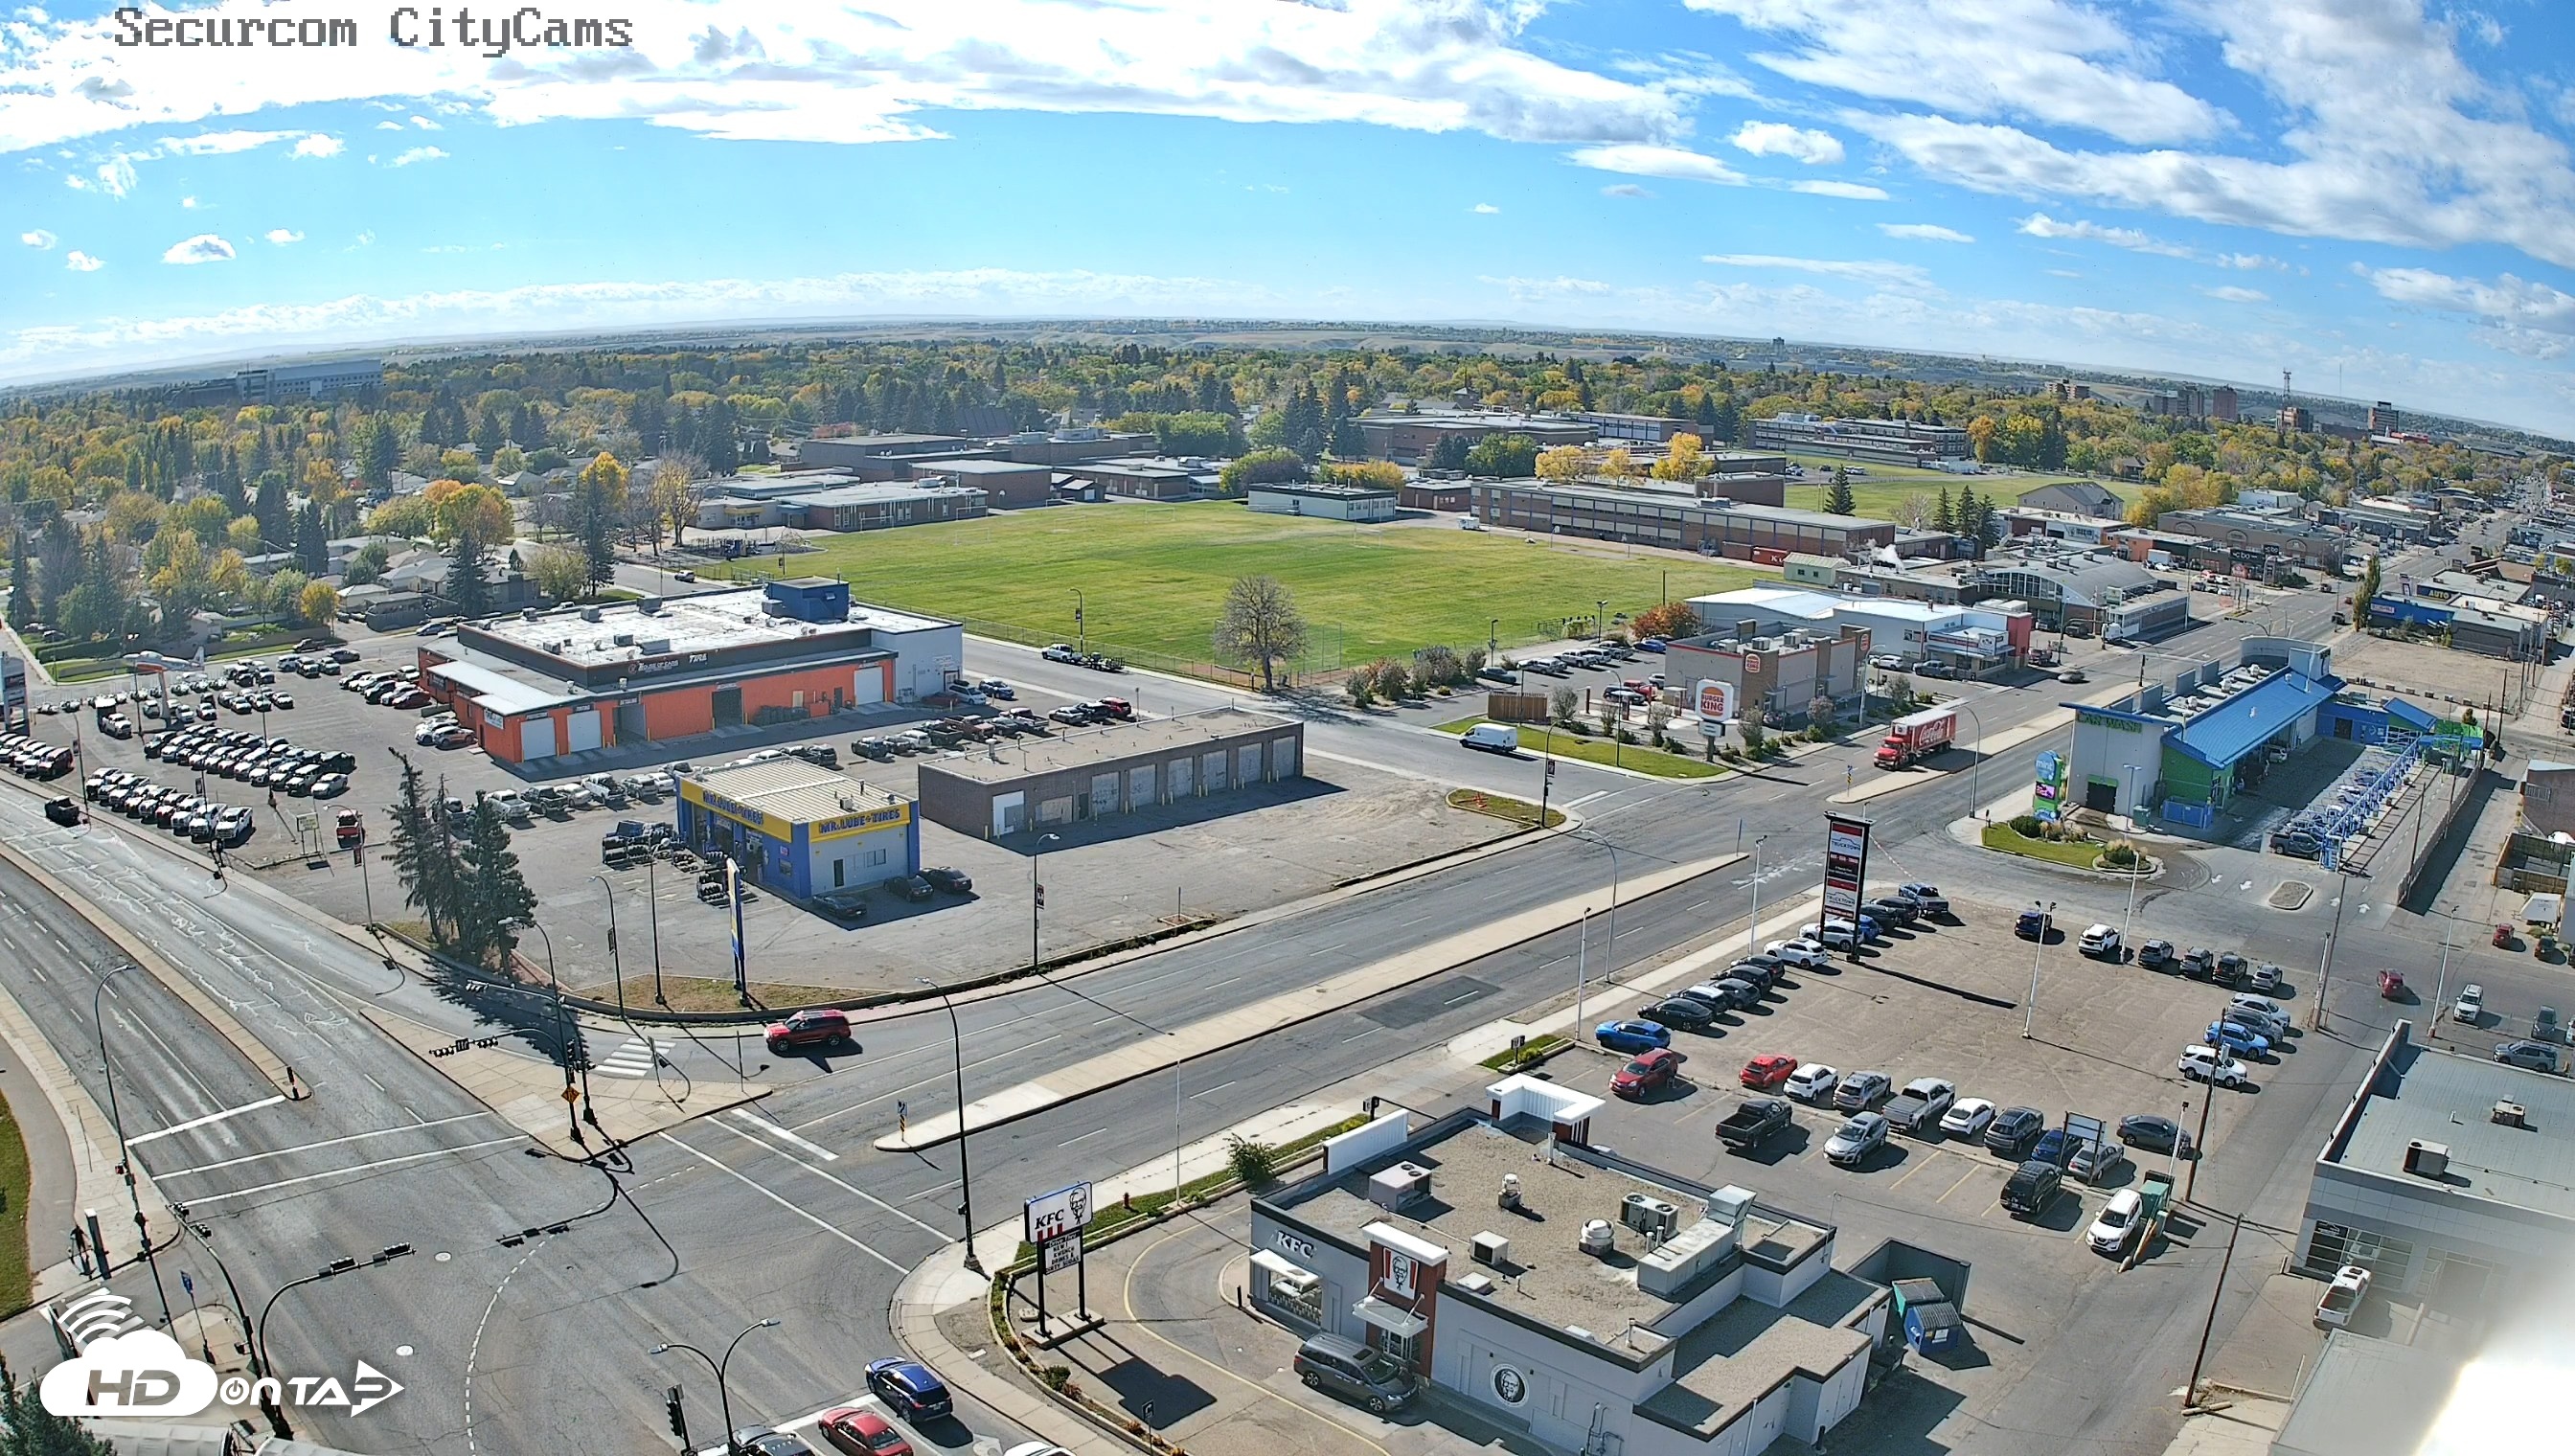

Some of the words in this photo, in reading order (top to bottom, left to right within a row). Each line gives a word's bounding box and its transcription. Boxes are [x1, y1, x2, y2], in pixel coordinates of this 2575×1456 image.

[2428, 590, 2450, 600] AUTO
[1701, 694, 1724, 704] BURGER
[1700, 700, 1724, 712] KING
[2076, 711, 2103, 726] CAR
[2106, 717, 2143, 734] WASH
[2036, 760, 2054, 770] mint
[1035, 1209, 1064, 1230] KFC
[1276, 1230, 1314, 1260] KFC
